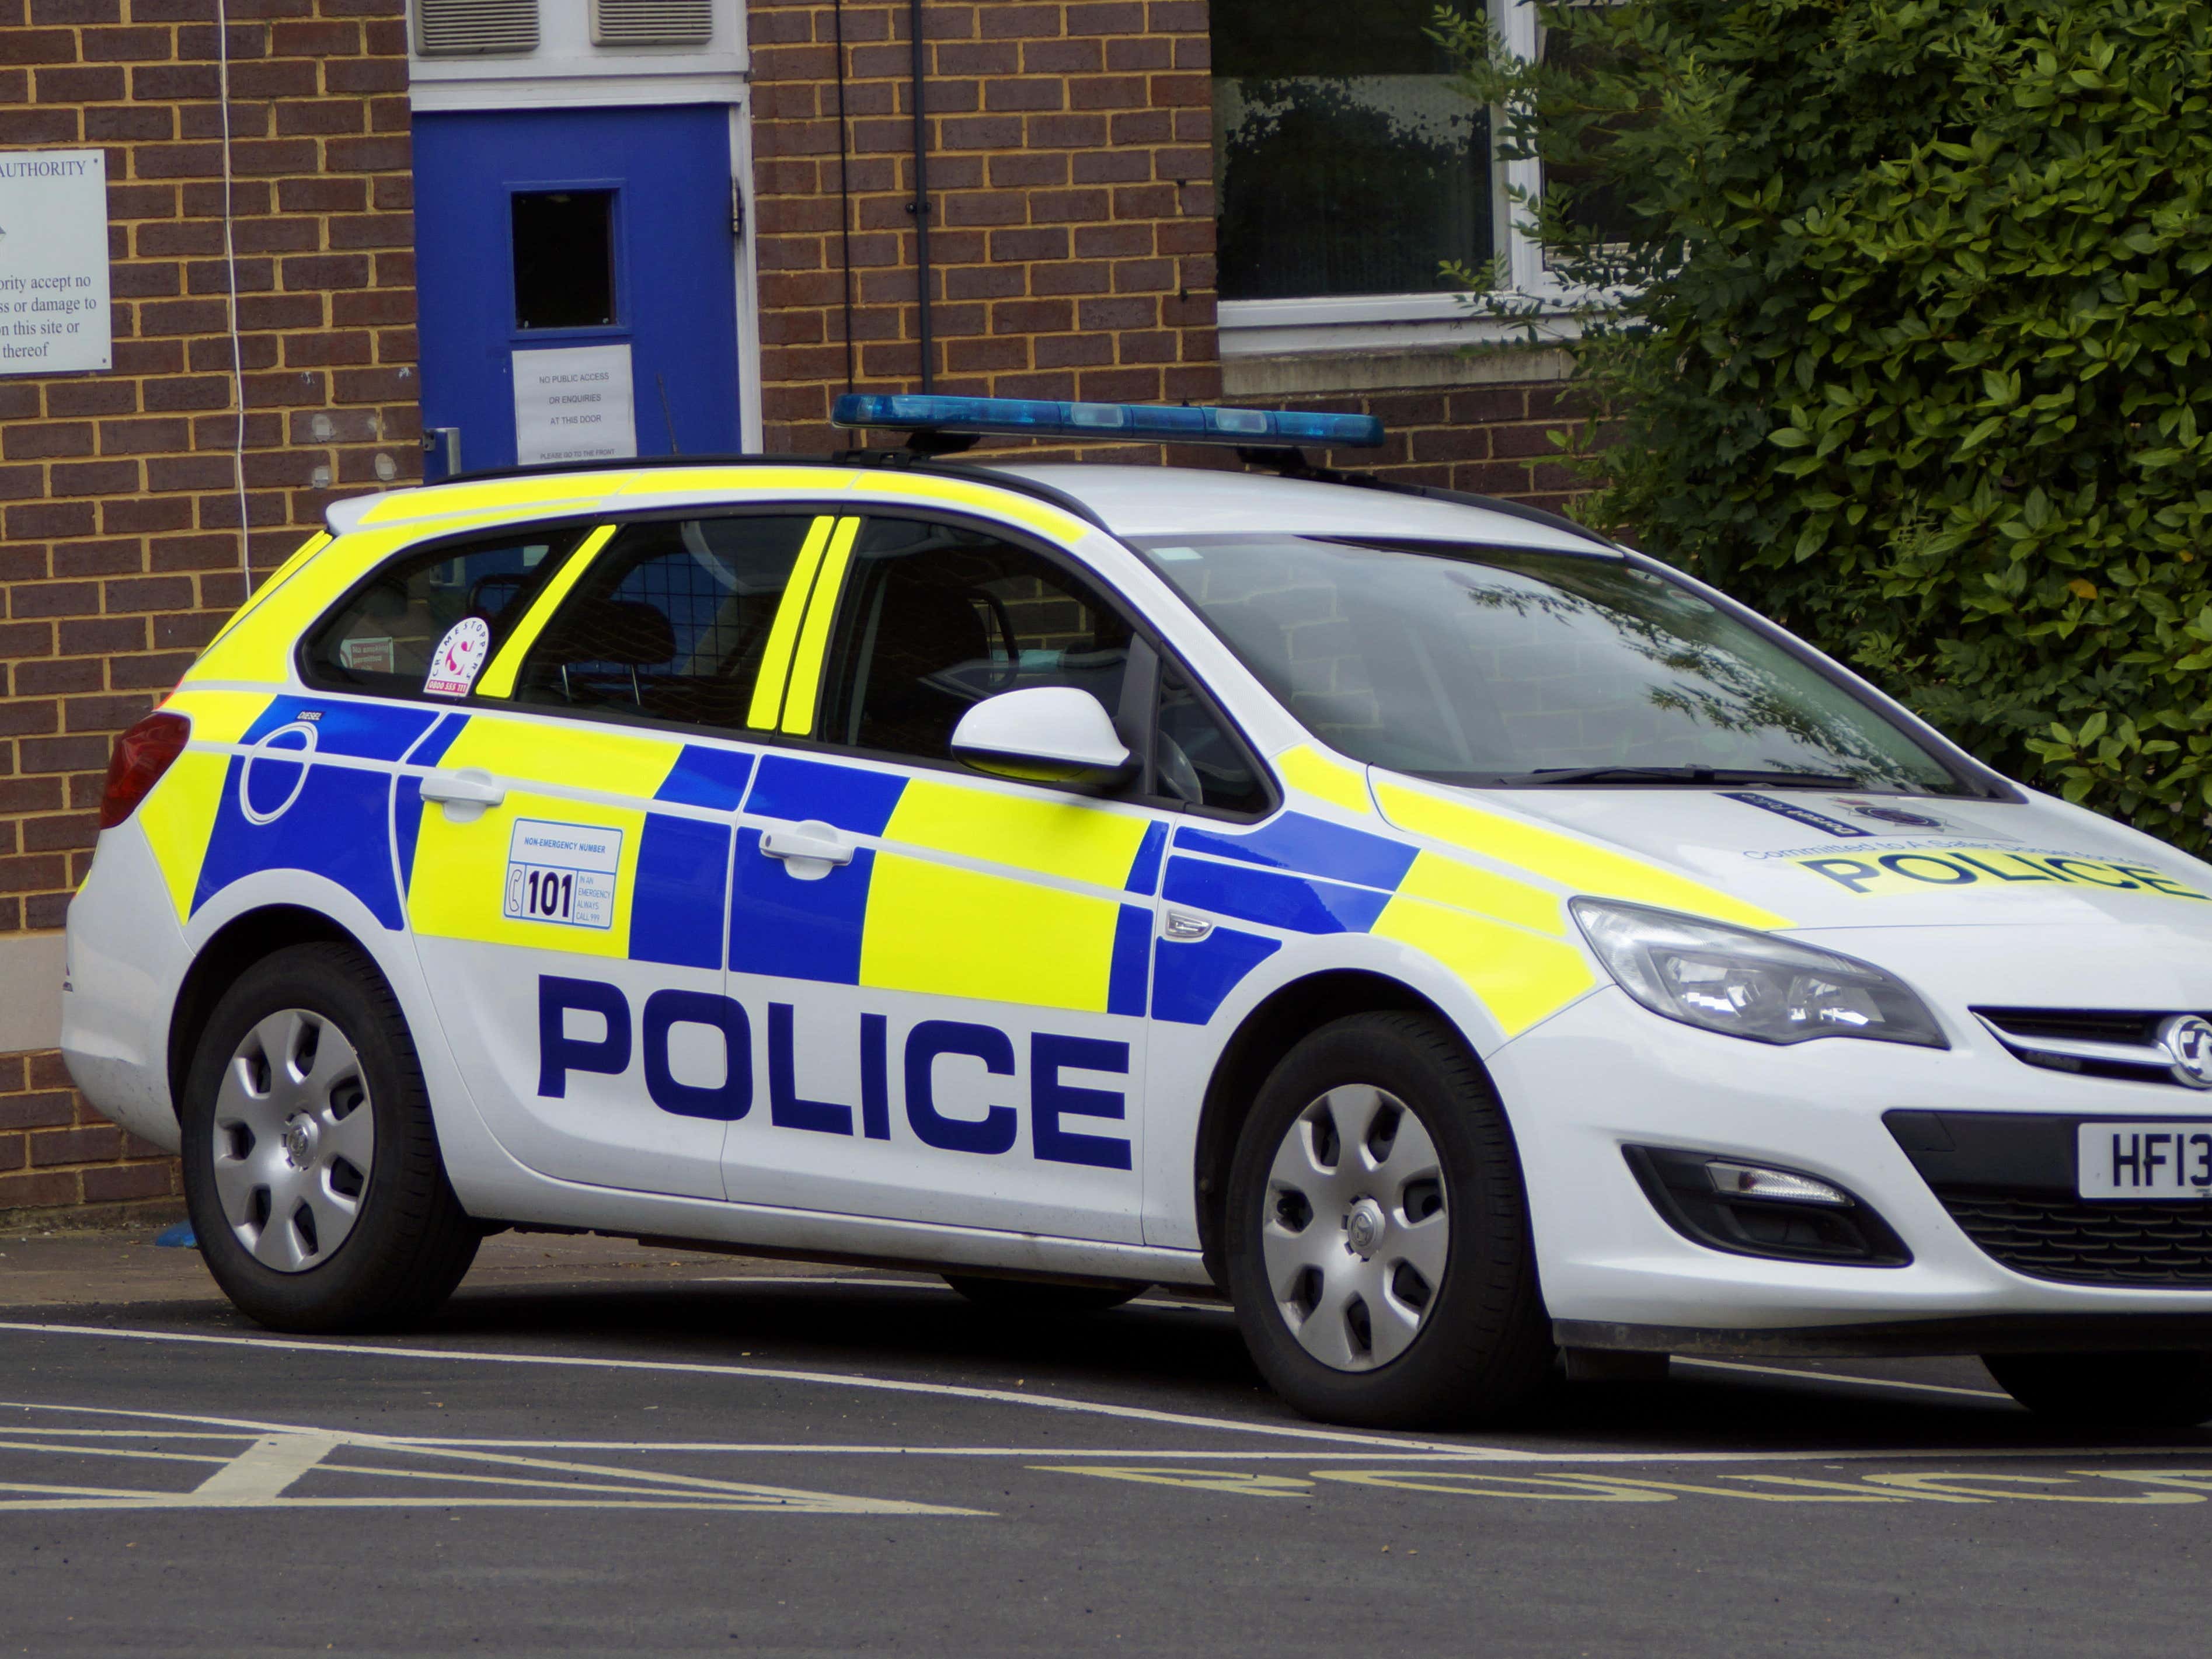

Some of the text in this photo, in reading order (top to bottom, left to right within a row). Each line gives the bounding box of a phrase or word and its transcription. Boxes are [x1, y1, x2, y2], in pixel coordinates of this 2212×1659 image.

[31, 275, 72, 292] accept
[75, 276, 91, 287] no
[14, 301, 27, 312] or
[31, 297, 80, 314] damage
[85, 297, 97, 309] to
[13, 320, 36, 335] this
[40, 319, 62, 334] site
[67, 322, 80, 333] or
[2, 341, 50, 358] thereof
[552, 374, 578, 383] PUBLIC
[580, 372, 609, 381] ACCESS
[549, 394, 601, 405] OR ENQUIRIES
[551, 414, 601, 425] AT THIS DOOR
[433, 621, 486, 679] CRIMESTOPPERS
[429, 680, 466, 692] 0800 555 111
[298, 711, 322, 720] DIESEL
[524, 837, 606, 853] NON-EMERGENCY NUMBER
[1743, 842, 1877, 859] Committed
[1875, 841, 1906, 851] to
[1796, 852, 2212, 900] POLICE
[528, 870, 573, 918] 101
[578, 887, 611, 898] EMERGENCY
[577, 900, 599, 909] ALWAYS
[576, 912, 589, 921] CALL
[537, 974, 1132, 1170] POLICE
[2113, 1133, 2212, 1186] HF13
